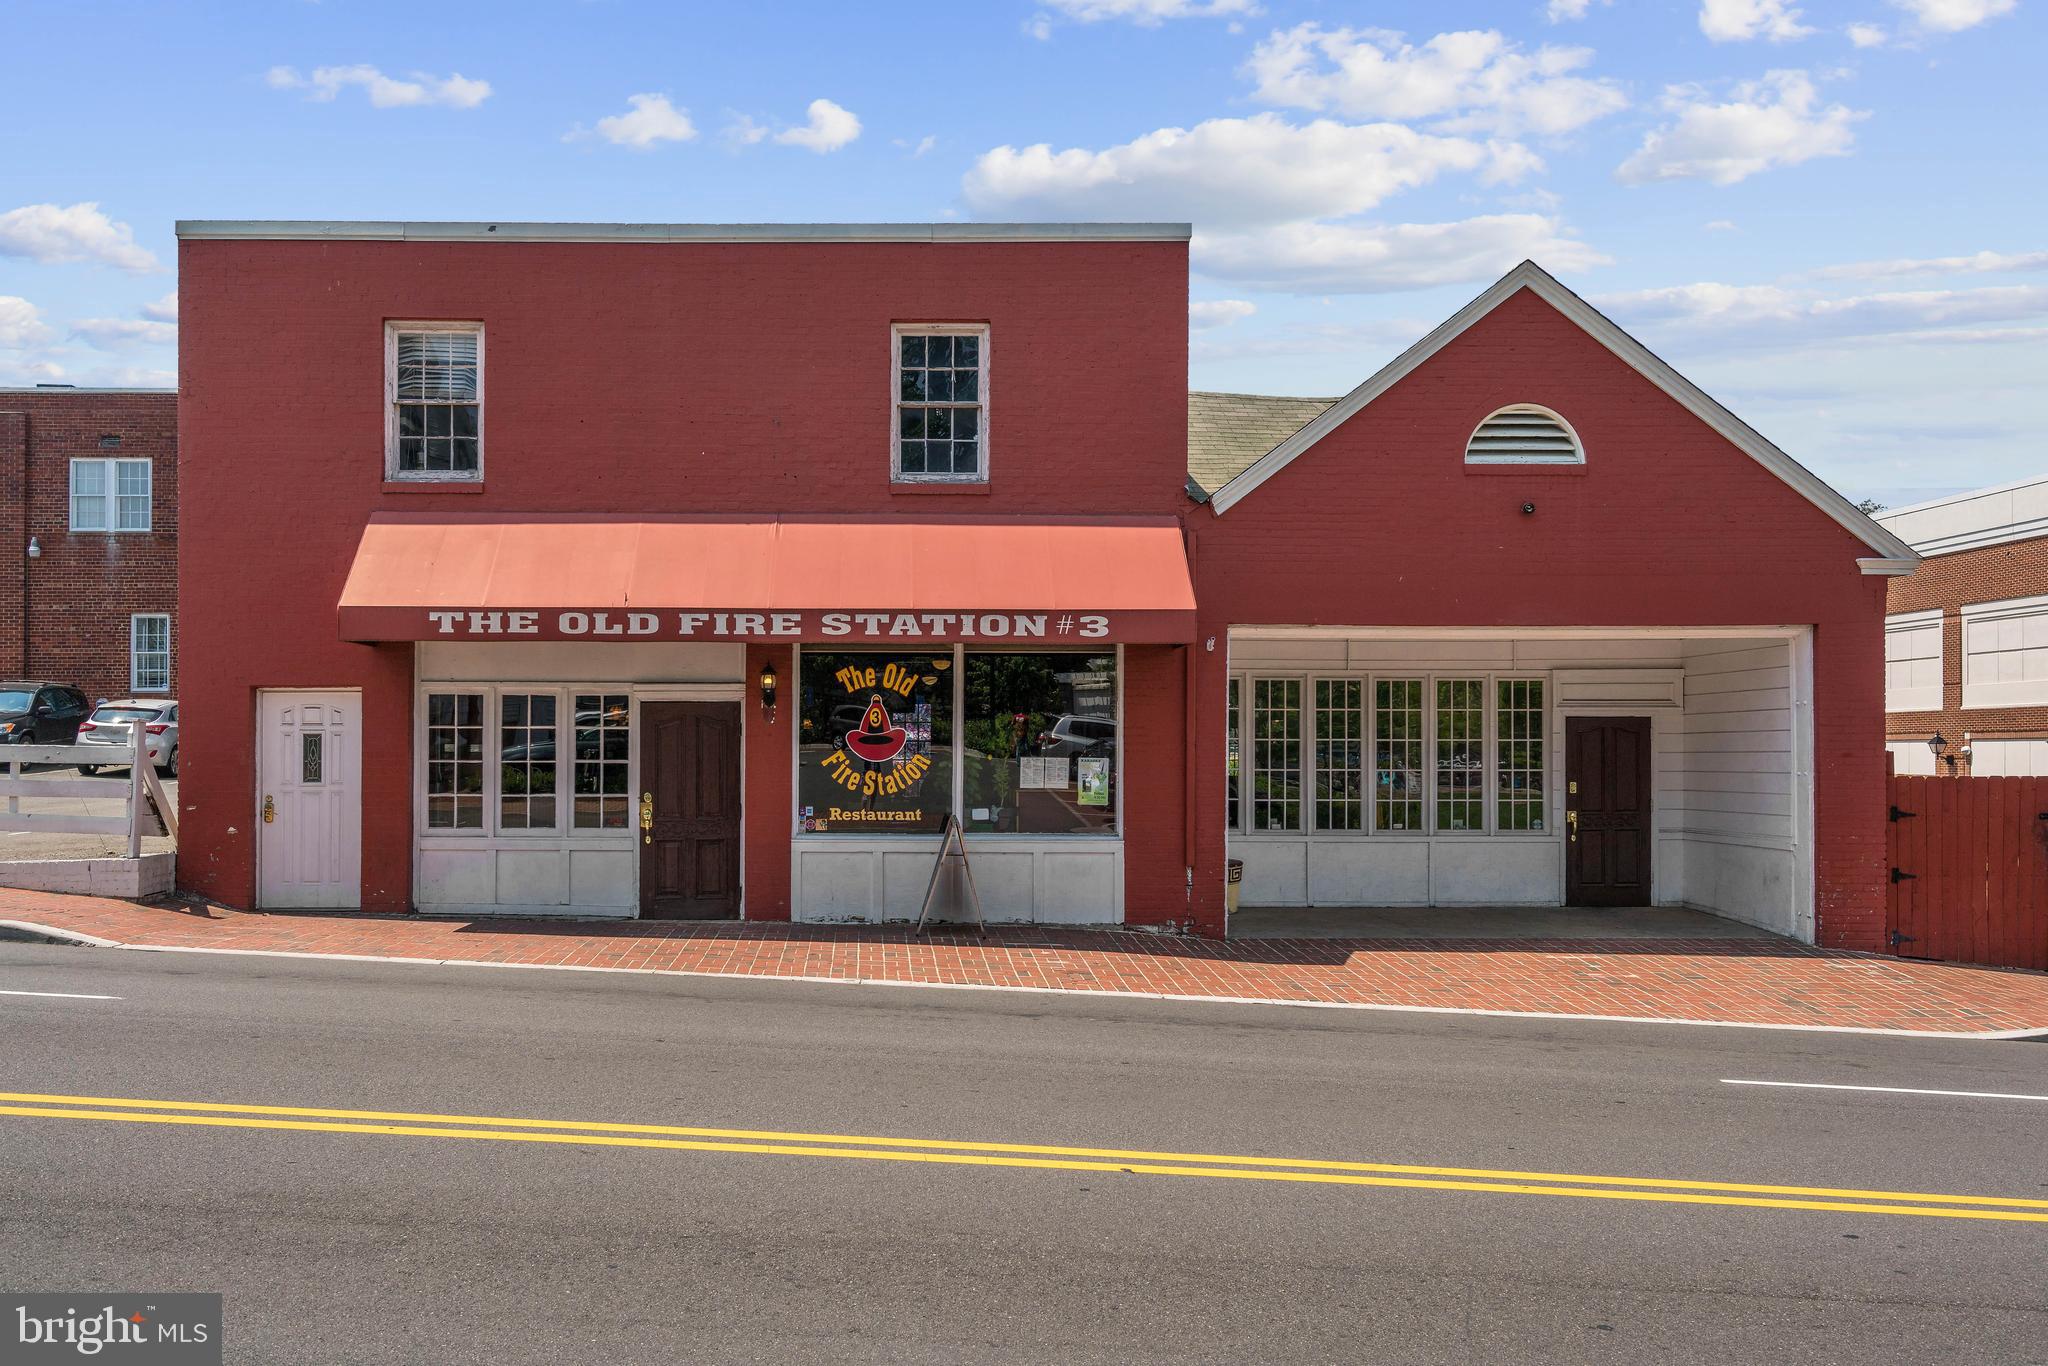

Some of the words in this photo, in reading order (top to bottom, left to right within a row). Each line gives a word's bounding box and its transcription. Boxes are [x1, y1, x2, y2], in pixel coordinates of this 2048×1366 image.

[429, 611, 539, 633] THE
[558, 613, 659, 635] OLD
[679, 613, 801, 636] FIRE
[821, 613, 1047, 637] STATION
[835, 665, 875, 694] The
[882, 663, 919, 697] Old
[871, 710, 880, 724] 3
[821, 749, 861, 791] Fire
[863, 753, 932, 796] Station
[829, 807, 922, 821] Restaurant
